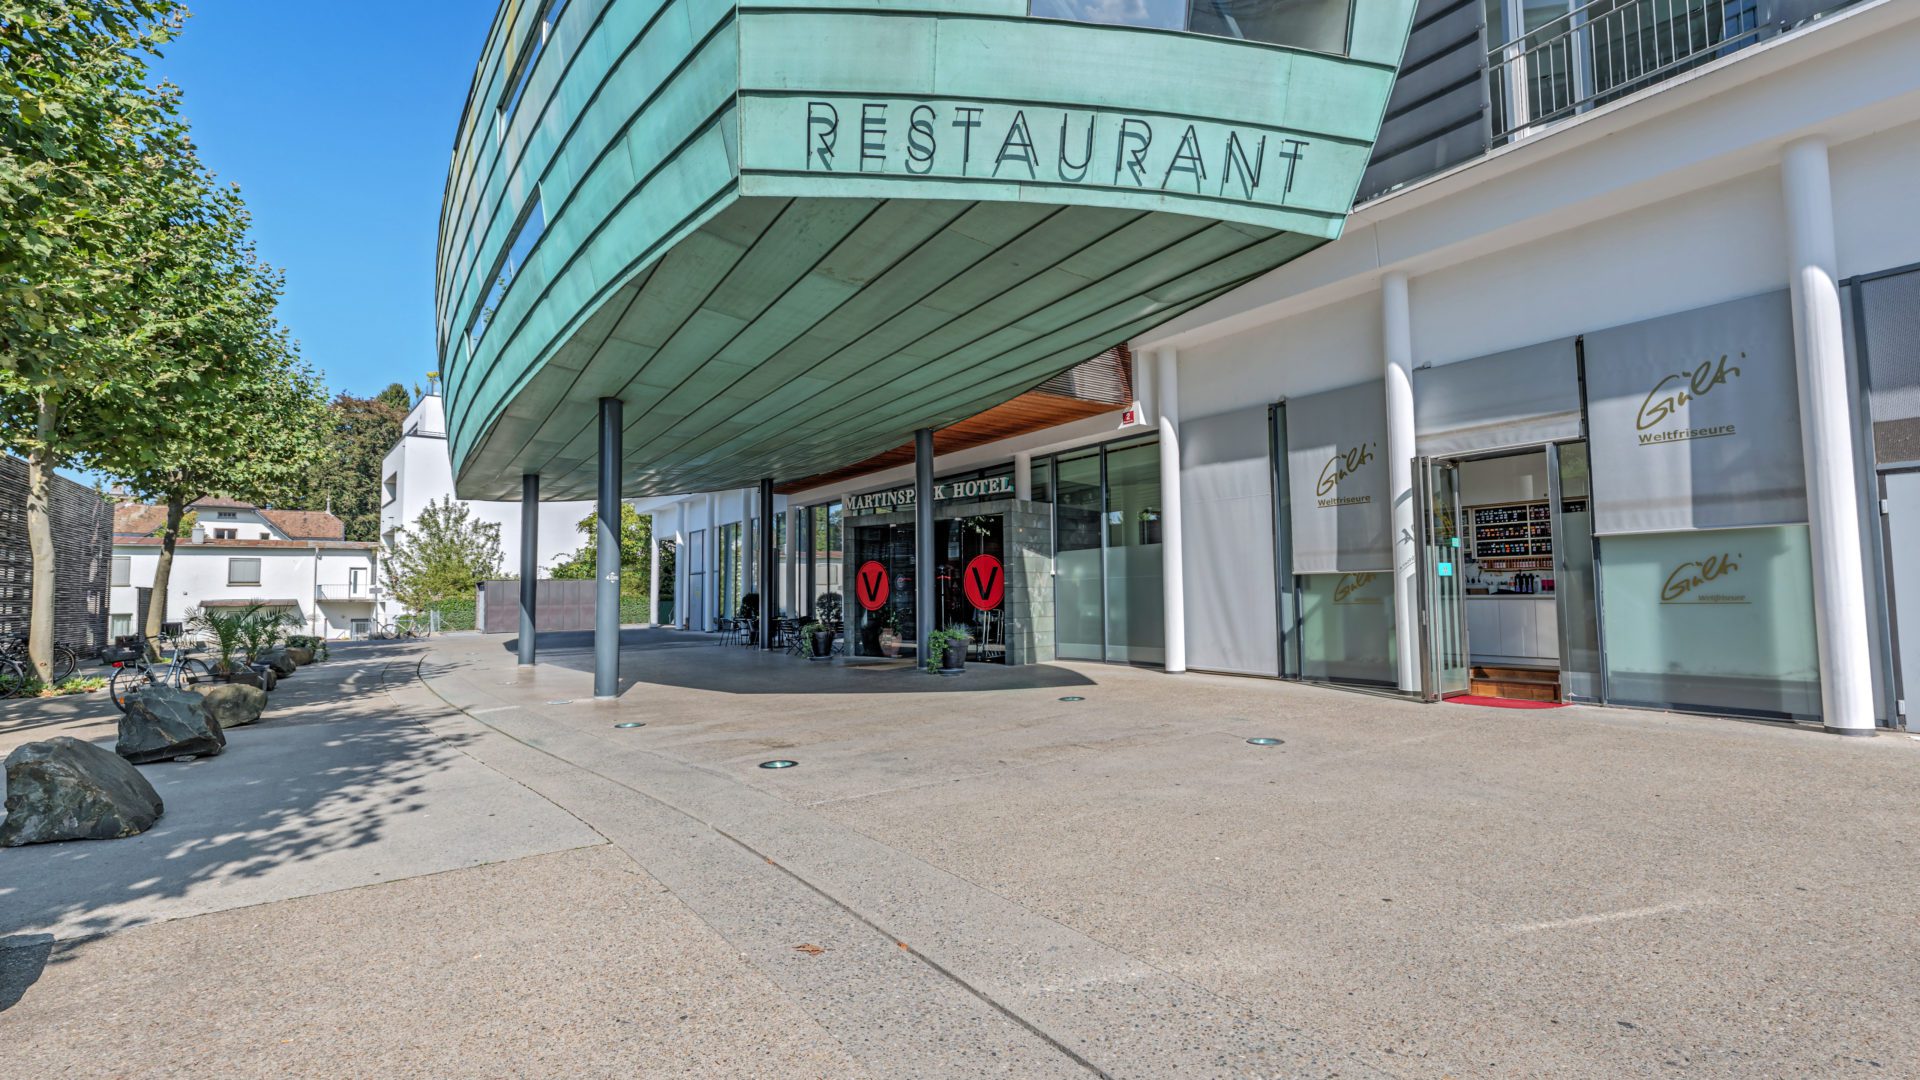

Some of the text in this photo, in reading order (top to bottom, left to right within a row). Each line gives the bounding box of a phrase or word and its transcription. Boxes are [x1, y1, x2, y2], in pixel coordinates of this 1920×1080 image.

[807, 101, 1310, 194] RESTAURANT
[1638, 424, 1735, 443] Weltfriseure
[846, 476, 1013, 511] MARTINSPK HOTEL
[1318, 495, 1371, 506] Weltfriseure
[862, 571, 883, 602] V
[972, 566, 999, 601] V
